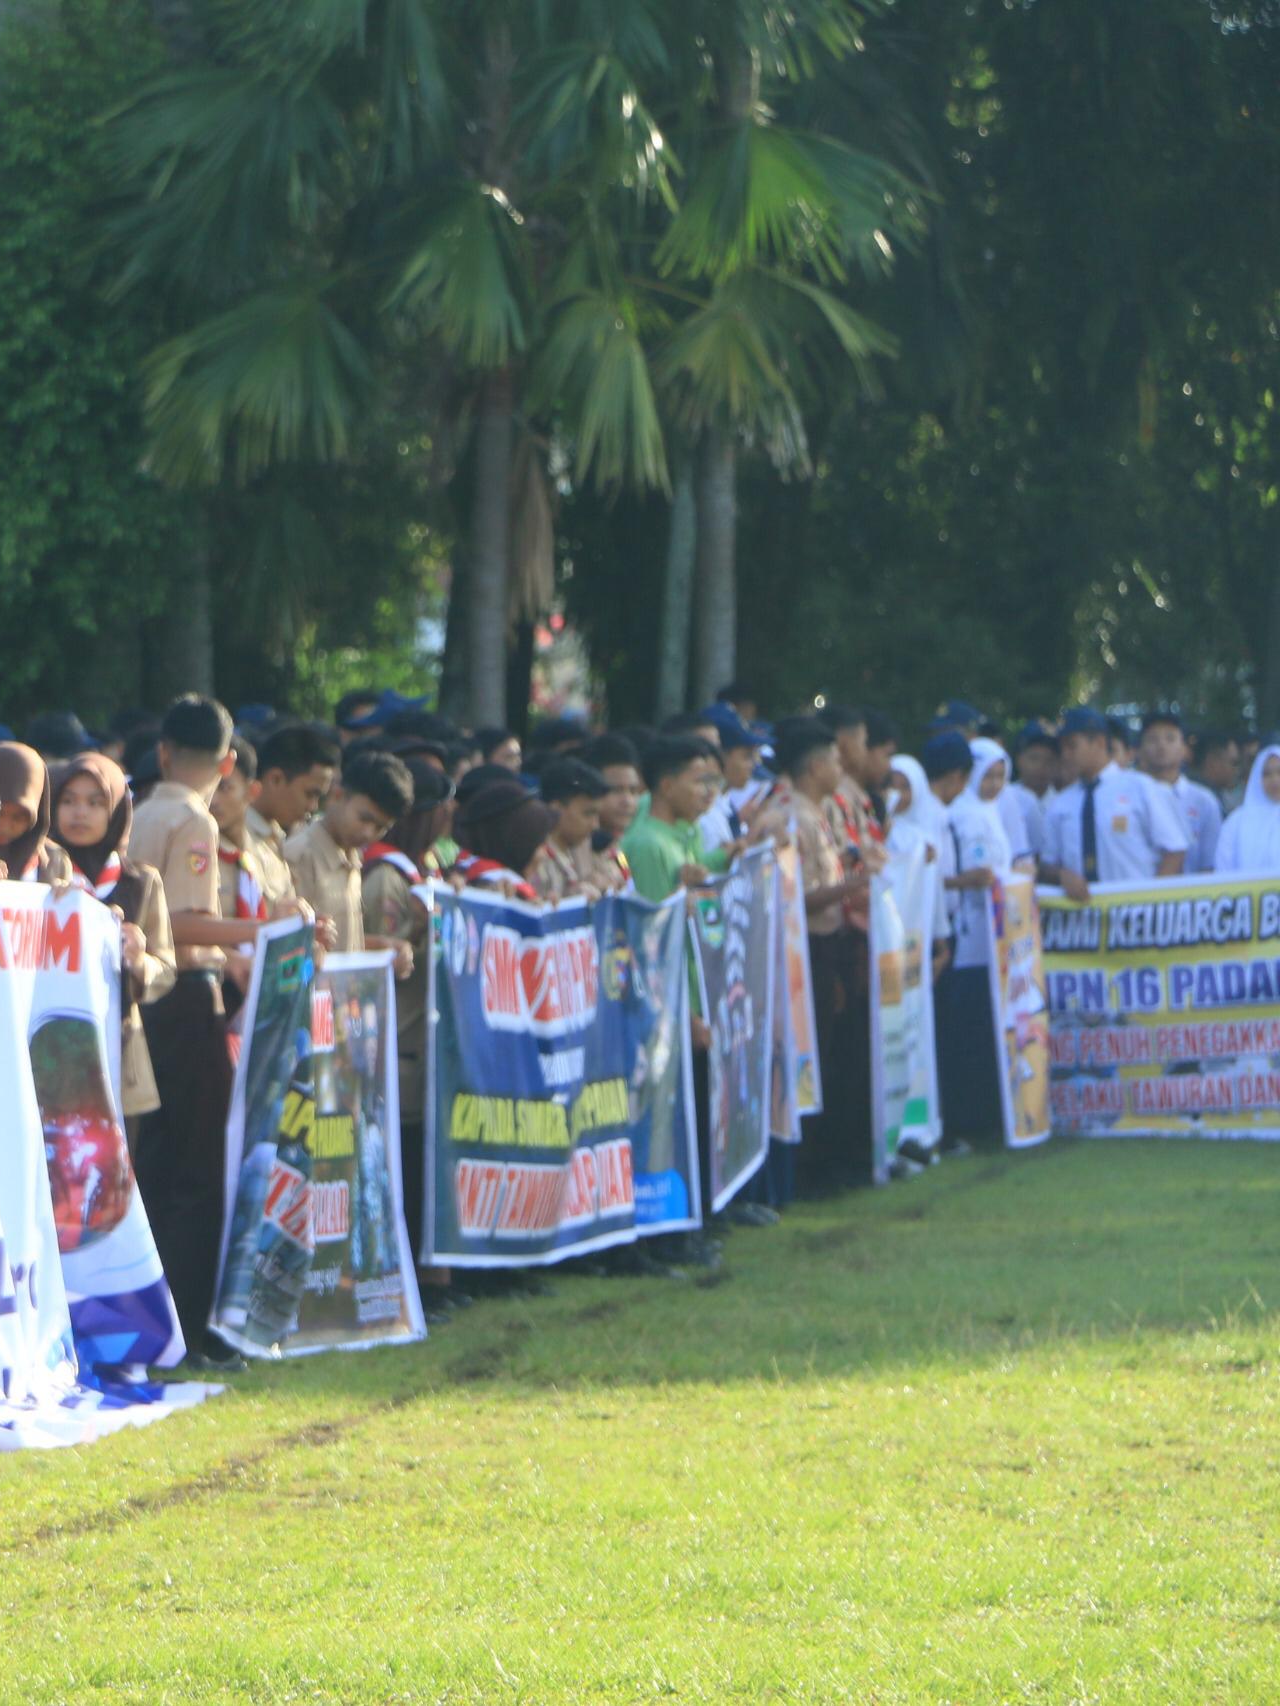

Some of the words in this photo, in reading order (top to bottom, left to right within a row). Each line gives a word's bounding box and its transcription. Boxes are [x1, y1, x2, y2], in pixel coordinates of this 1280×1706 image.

[1106, 895, 1253, 951] KELUARGA
[1113, 966, 1161, 1012] 16
[1078, 1026, 1151, 1063] PENUH
[1131, 1076, 1234, 1114] TAWURAN
